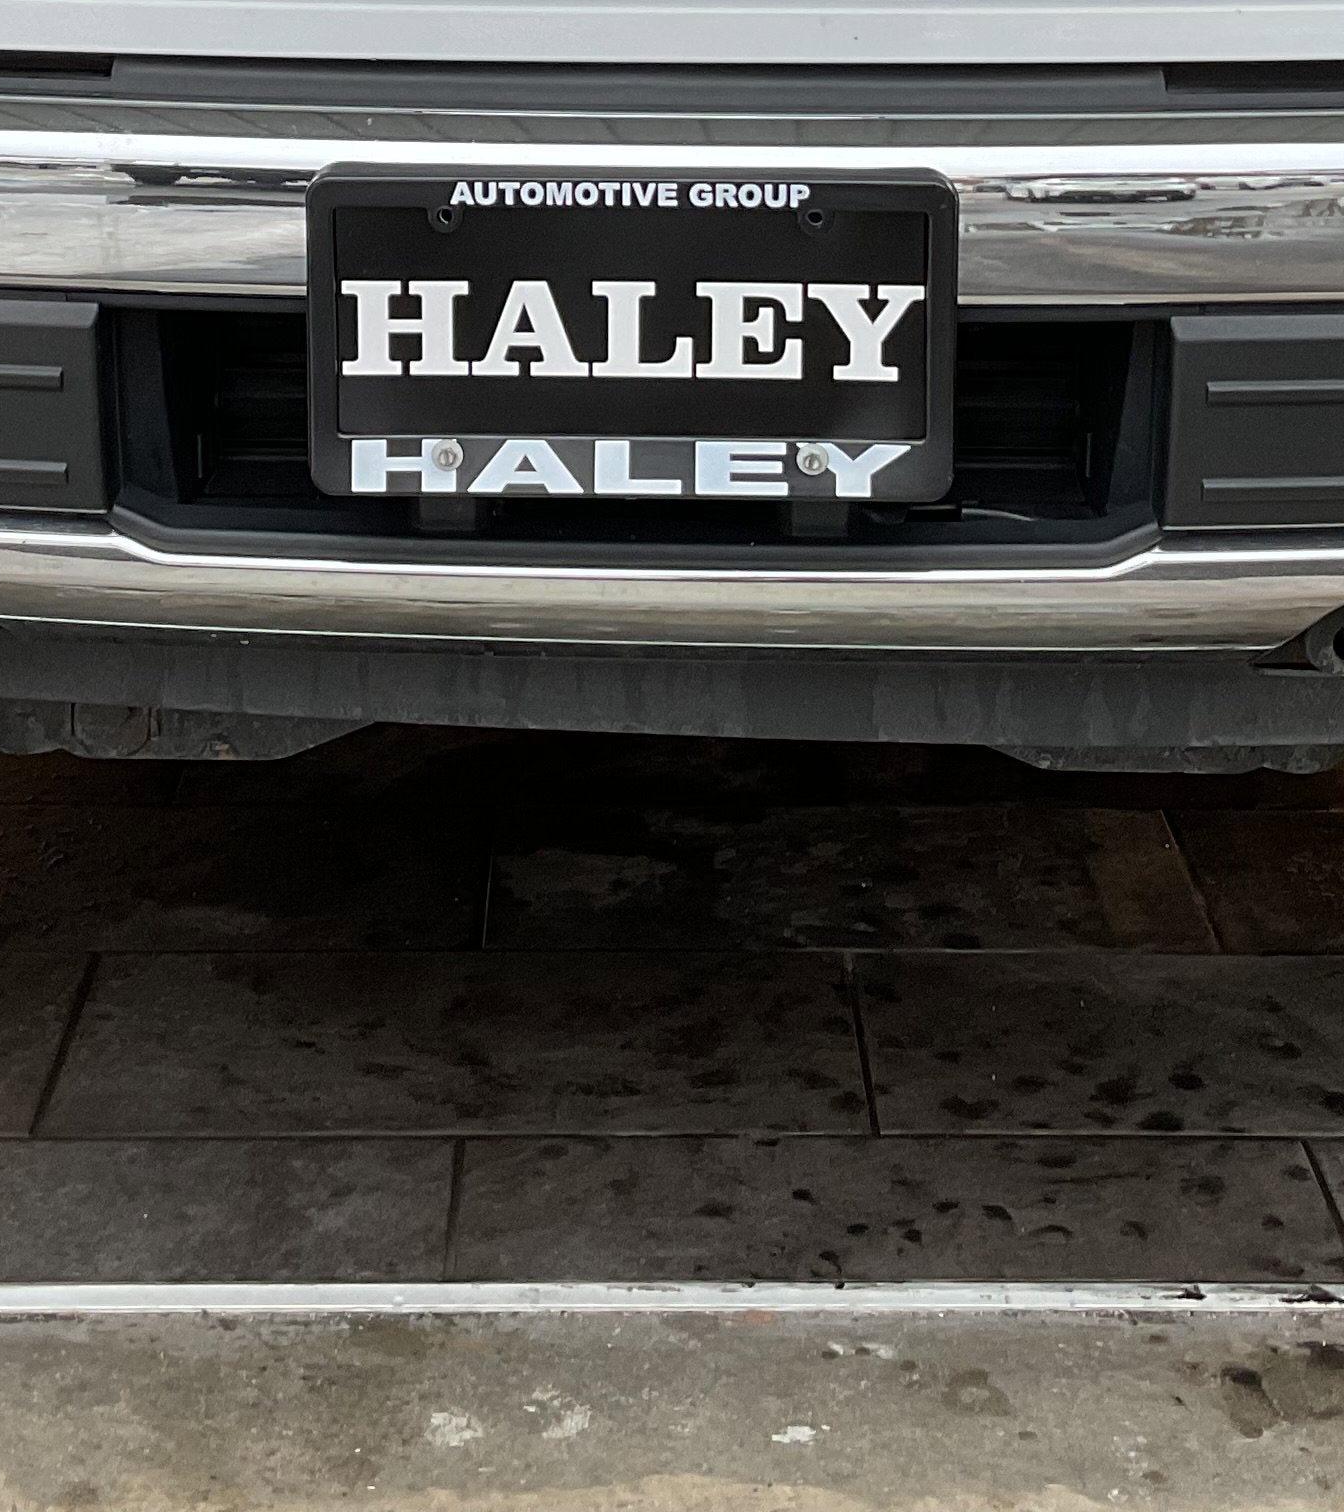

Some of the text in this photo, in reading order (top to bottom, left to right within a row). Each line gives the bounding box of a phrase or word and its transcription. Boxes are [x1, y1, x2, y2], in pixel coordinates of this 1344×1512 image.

[449, 181, 811, 209] AUTOMOTIVE GROUP
[340, 279, 925, 382] HALEY
[350, 439, 912, 498] HALEY
